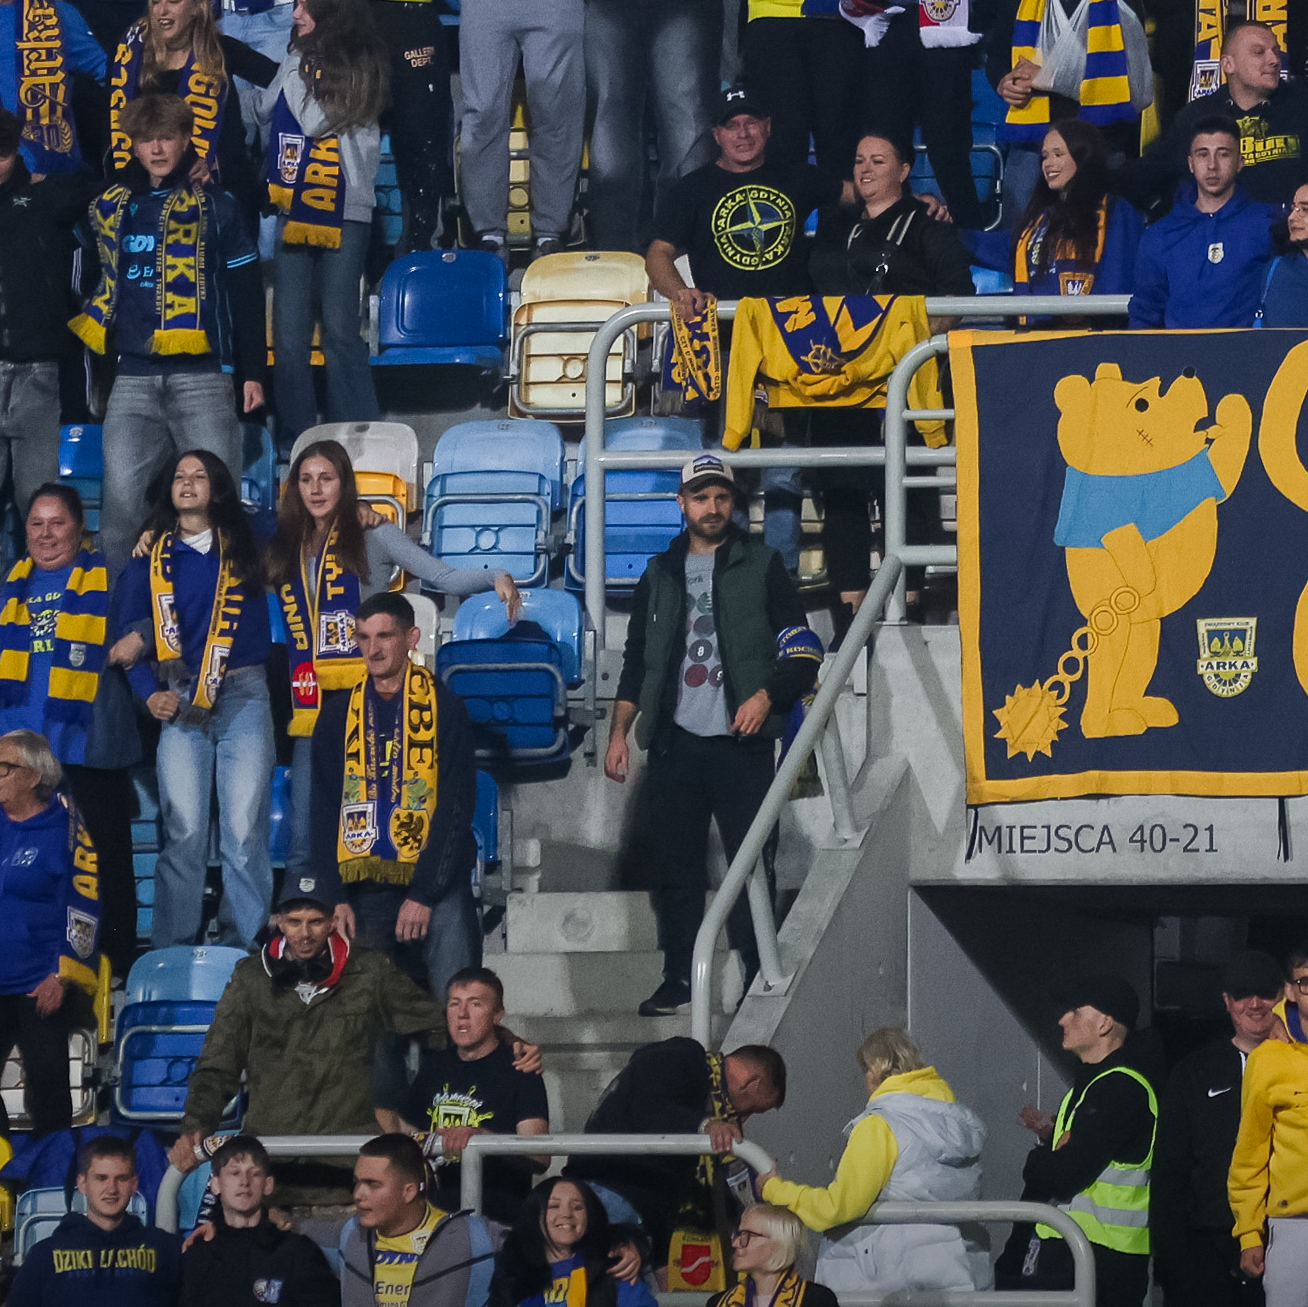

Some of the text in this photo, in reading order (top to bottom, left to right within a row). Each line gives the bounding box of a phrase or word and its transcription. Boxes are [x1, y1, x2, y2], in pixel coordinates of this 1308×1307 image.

[302, 135, 340, 211] ARK
[718, 193, 743, 230] ARKA
[748, 189, 793, 219] GDYNIA
[337, 616, 351, 654] ARKA
[697, 644, 705, 657] 8
[1203, 659, 1253, 673] ARKA
[1205, 673, 1251, 695] GDYNIA
[343, 830, 377, 840] ARKA
[977, 823, 1219, 854] MIEJSCA 40-21
[375, 1280, 413, 1297] Ener
